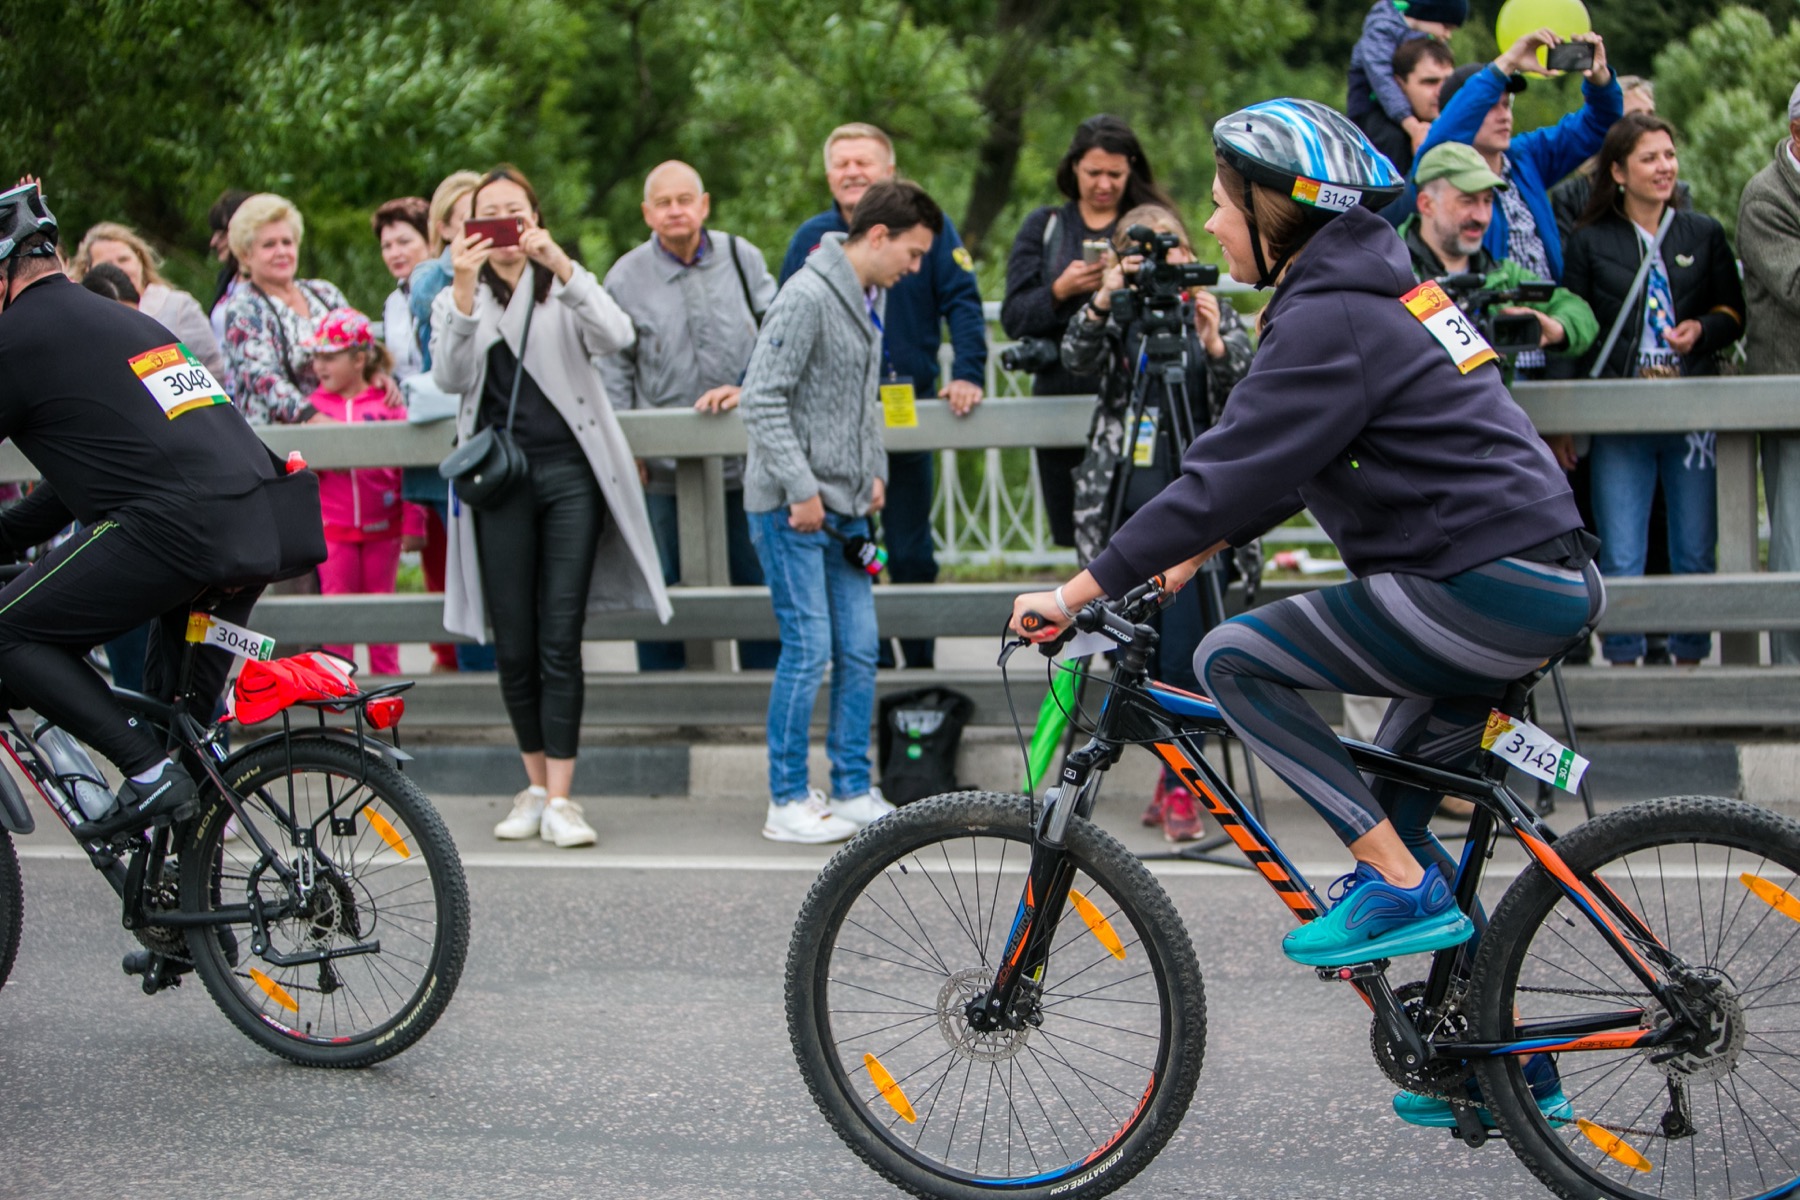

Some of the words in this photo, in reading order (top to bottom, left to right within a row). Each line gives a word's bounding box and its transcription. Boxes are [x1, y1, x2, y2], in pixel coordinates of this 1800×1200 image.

[1321, 190, 1356, 208] 3142
[163, 369, 212, 396] 3048
[216, 626, 259, 657] 3048
[1505, 732, 1557, 776] 3142
[375, 973, 438, 1046] SCHWALBE
[1573, 1038, 1630, 1050] ASPECT
